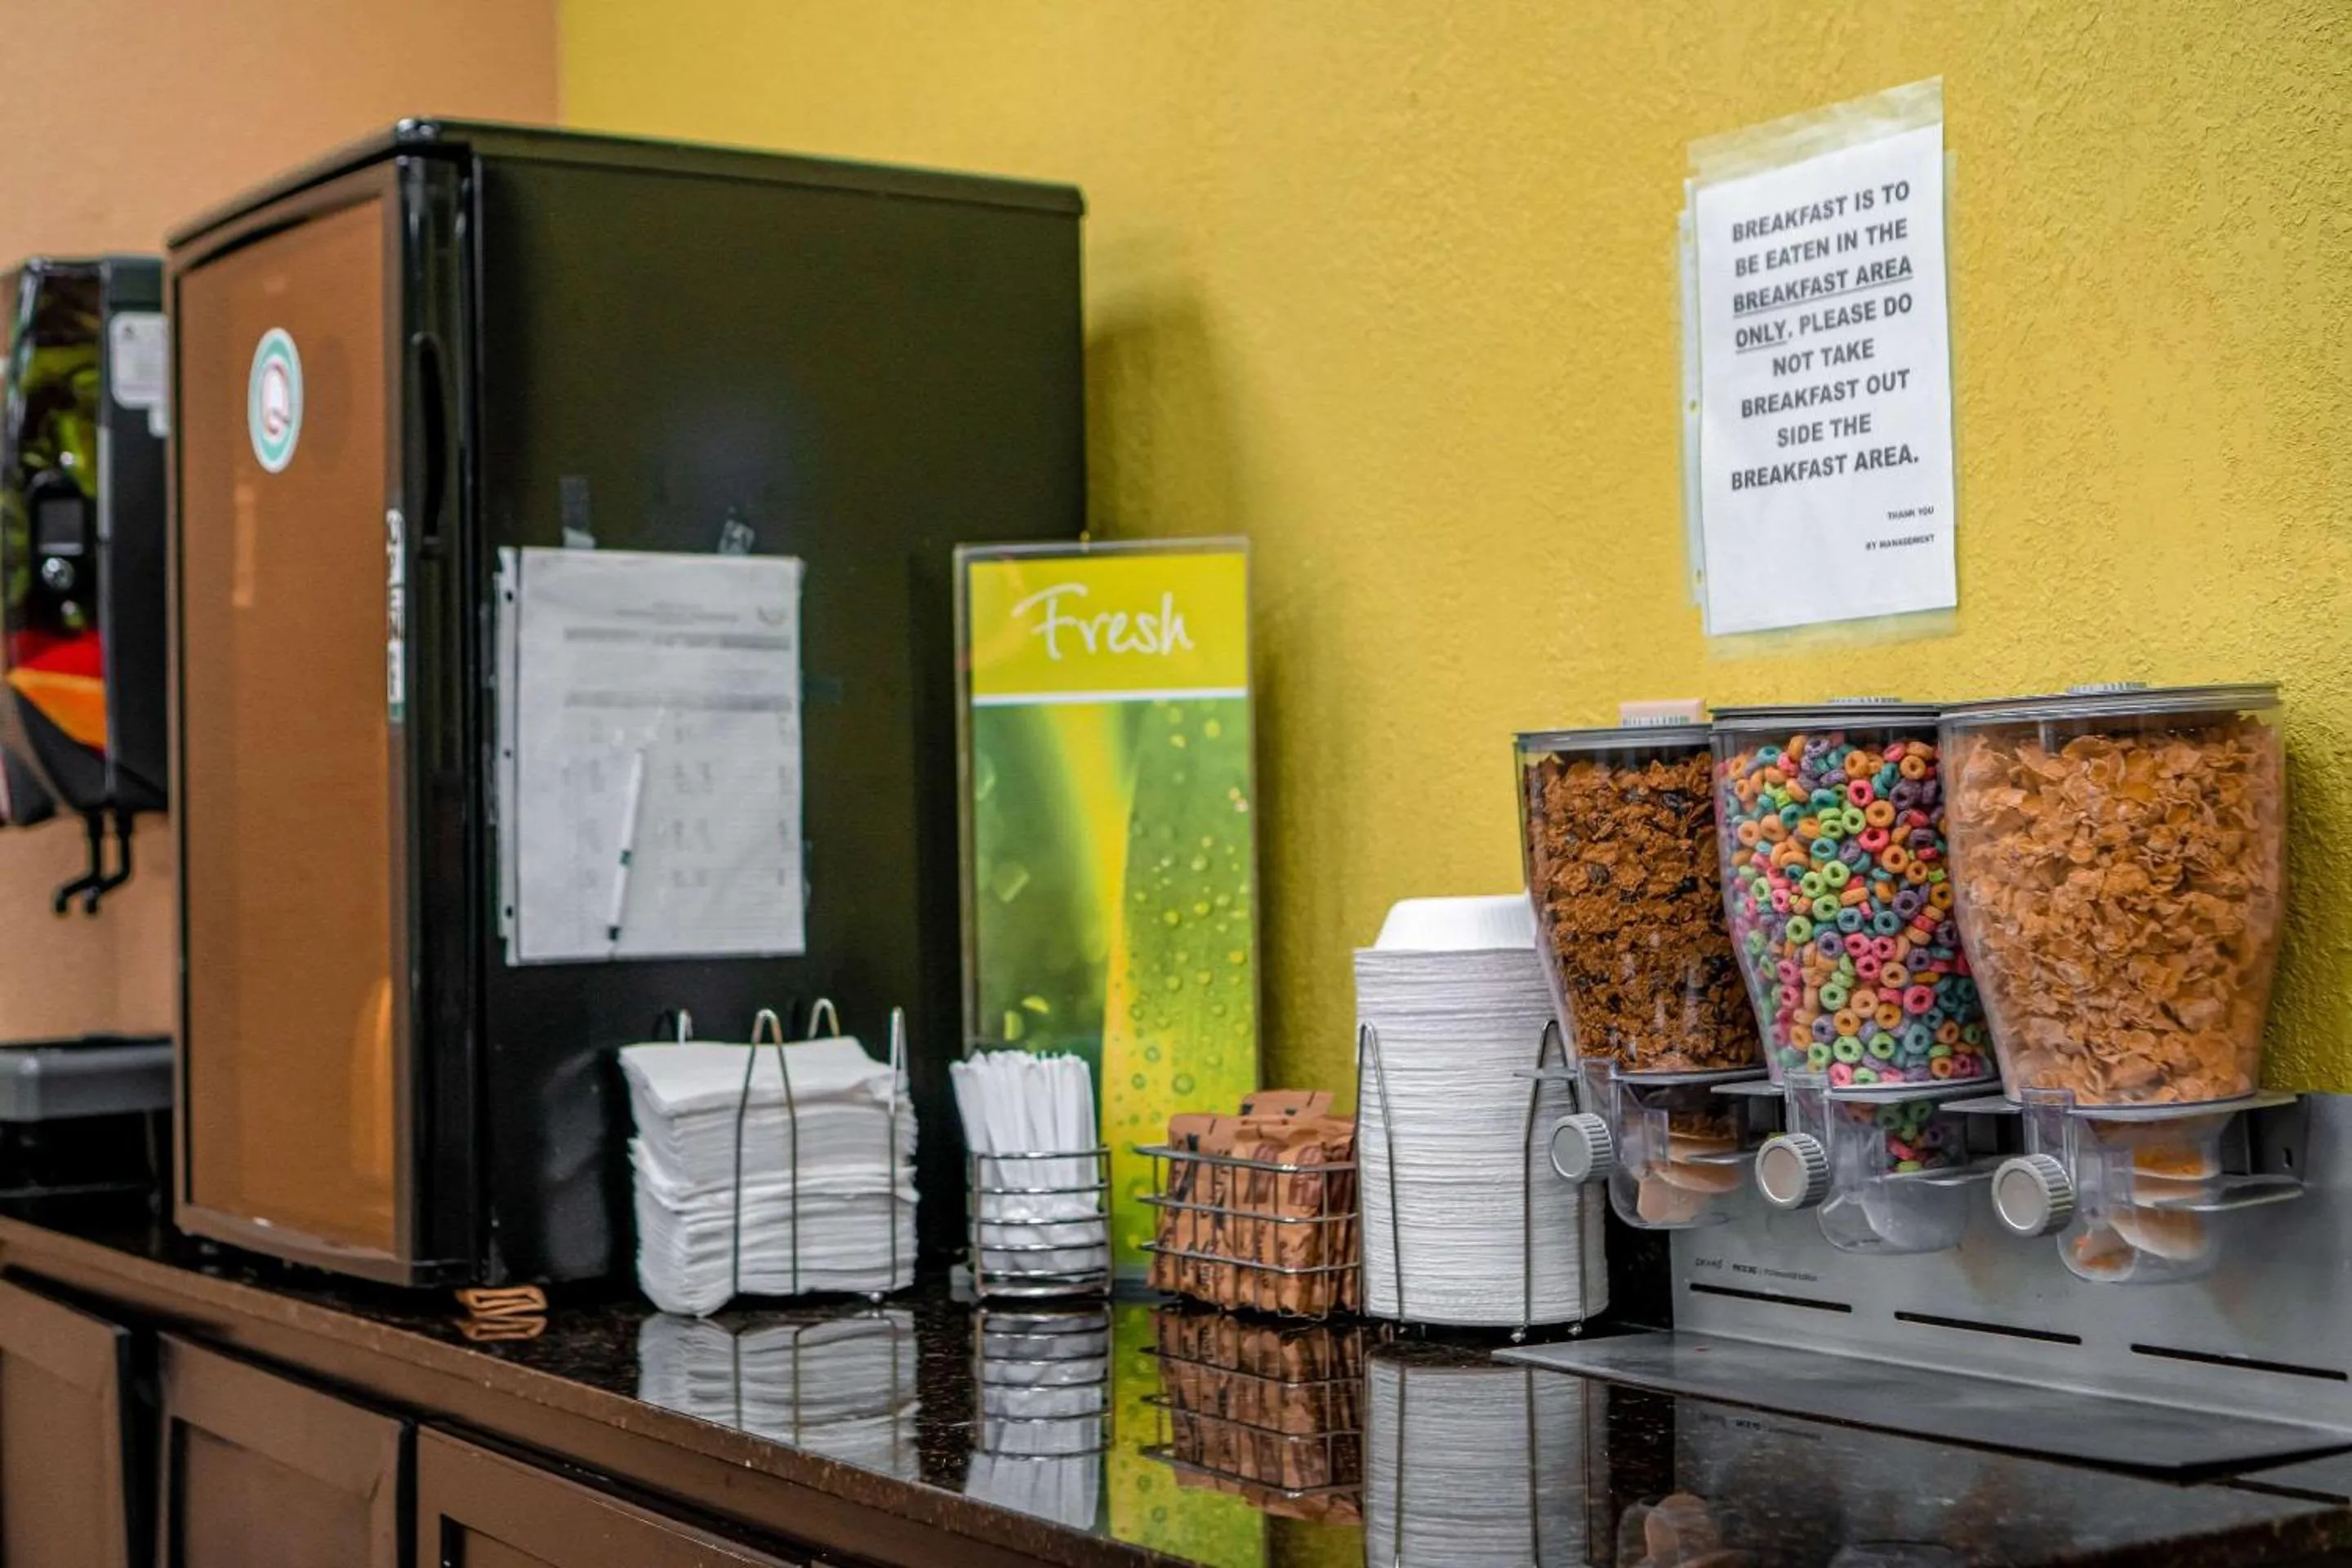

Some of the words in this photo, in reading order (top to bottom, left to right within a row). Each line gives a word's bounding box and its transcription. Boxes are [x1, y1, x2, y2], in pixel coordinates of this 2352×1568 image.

[1732, 196, 1847, 243] BREAKFAST
[1855, 189, 1874, 212] IS
[1882, 180, 1909, 204] TO
[1735, 255, 1759, 278] BE
[1766, 238, 1830, 271] EATEN
[1837, 230, 1857, 253] IN
[1866, 219, 1907, 246] THE
[1733, 271, 1847, 314] BREAKFAST
[1855, 256, 1913, 285] AREA
[1800, 301, 1877, 336] PLEASE
[1883, 293, 1913, 317] DO
[1772, 352, 1814, 376] NOT
[1820, 338, 1875, 367] TAKE
[1741, 379, 1859, 418] BREAKFAST
[1866, 369, 1910, 394] OUT
[1777, 421, 1823, 448] SIDE
[1829, 413, 1871, 439] THE
[1731, 456, 1847, 491] BREAKFAST
[1855, 444, 1918, 472] AREA.
[1887, 510, 1915, 520] THANK
[1918, 506, 1934, 516] YOU
[1012, 583, 1195, 660] Fresh
